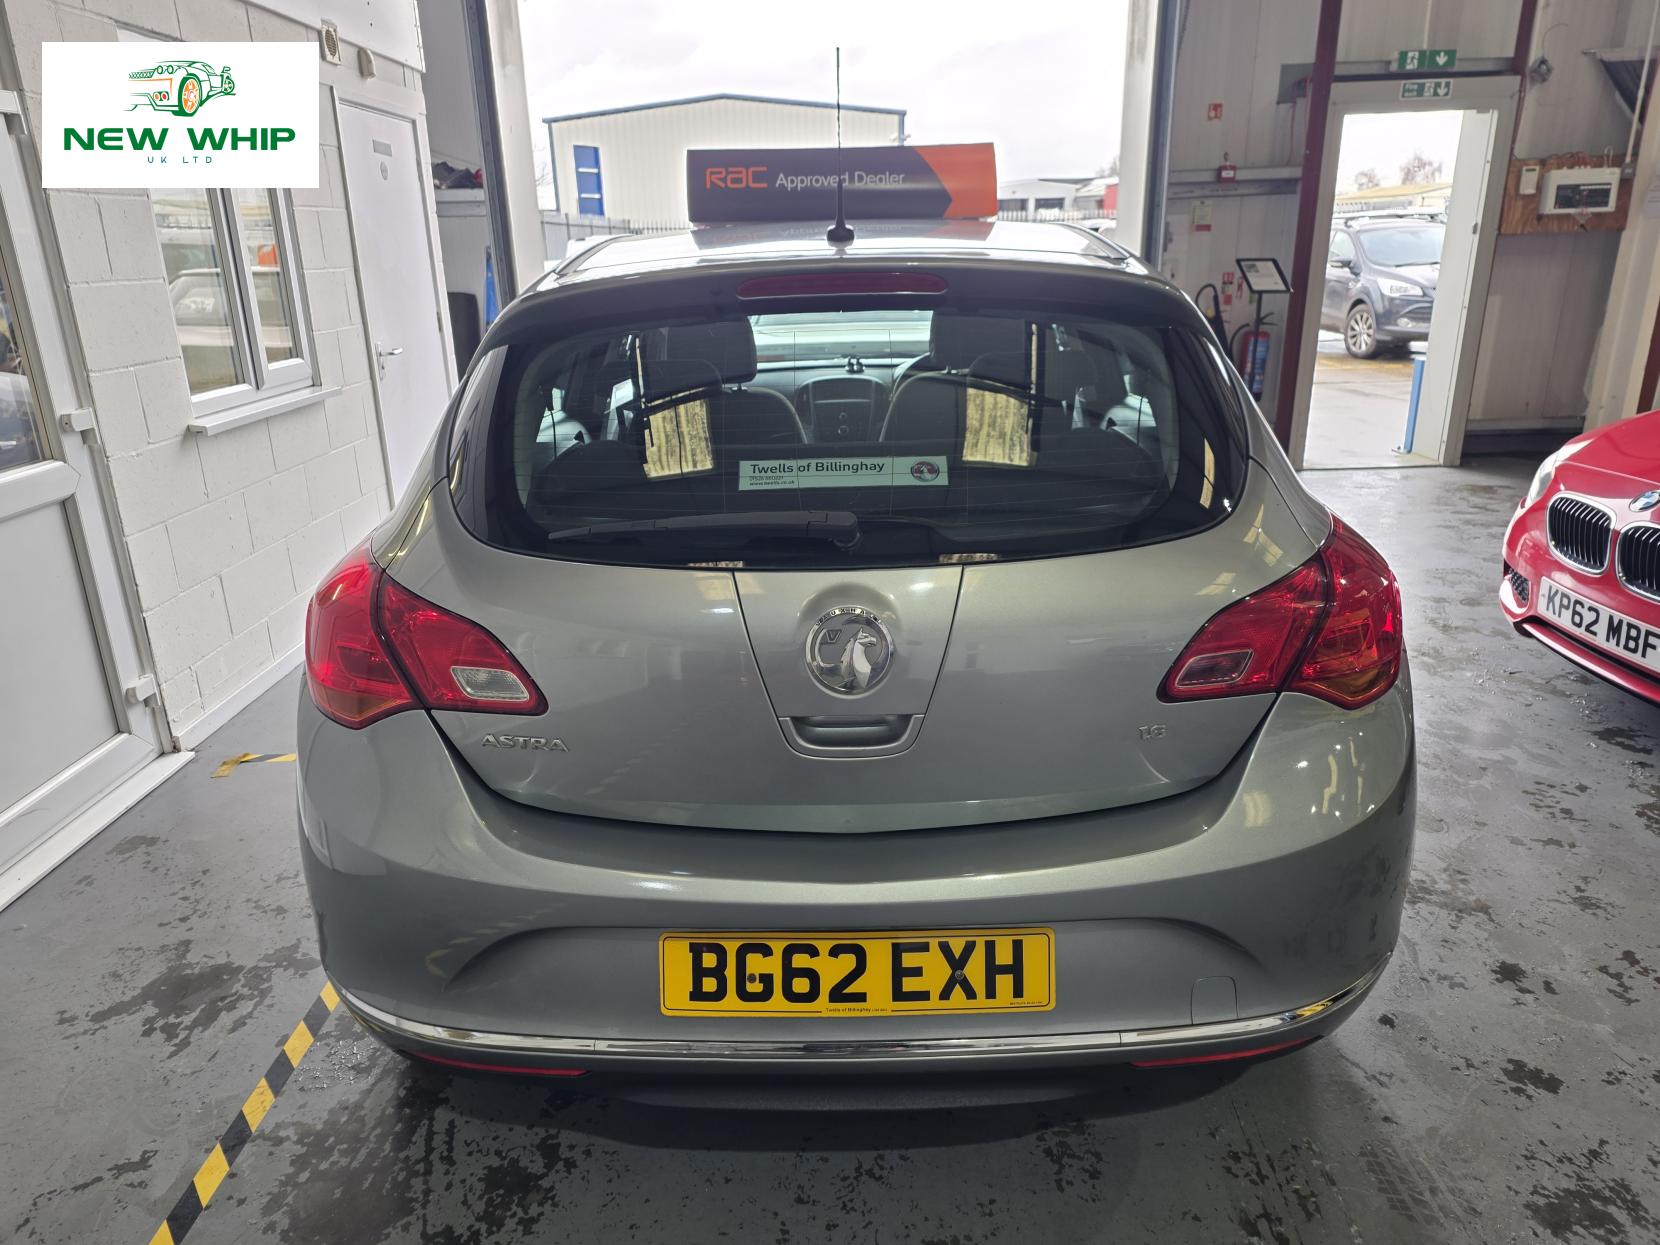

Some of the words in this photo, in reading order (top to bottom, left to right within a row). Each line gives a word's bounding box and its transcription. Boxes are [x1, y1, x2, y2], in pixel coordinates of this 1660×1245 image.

[775, 172, 849, 192] Approved
[854, 171, 905, 185] Dealer
[751, 464, 793, 474] Twells
[798, 463, 811, 473] of
[815, 461, 885, 475] Billinghay
[1545, 584, 1598, 636] KP62
[1606, 614, 1660, 659] MBF
[482, 734, 569, 752] ASTRA
[688, 942, 867, 1003] BG62
[891, 939, 1024, 1001] EXH
